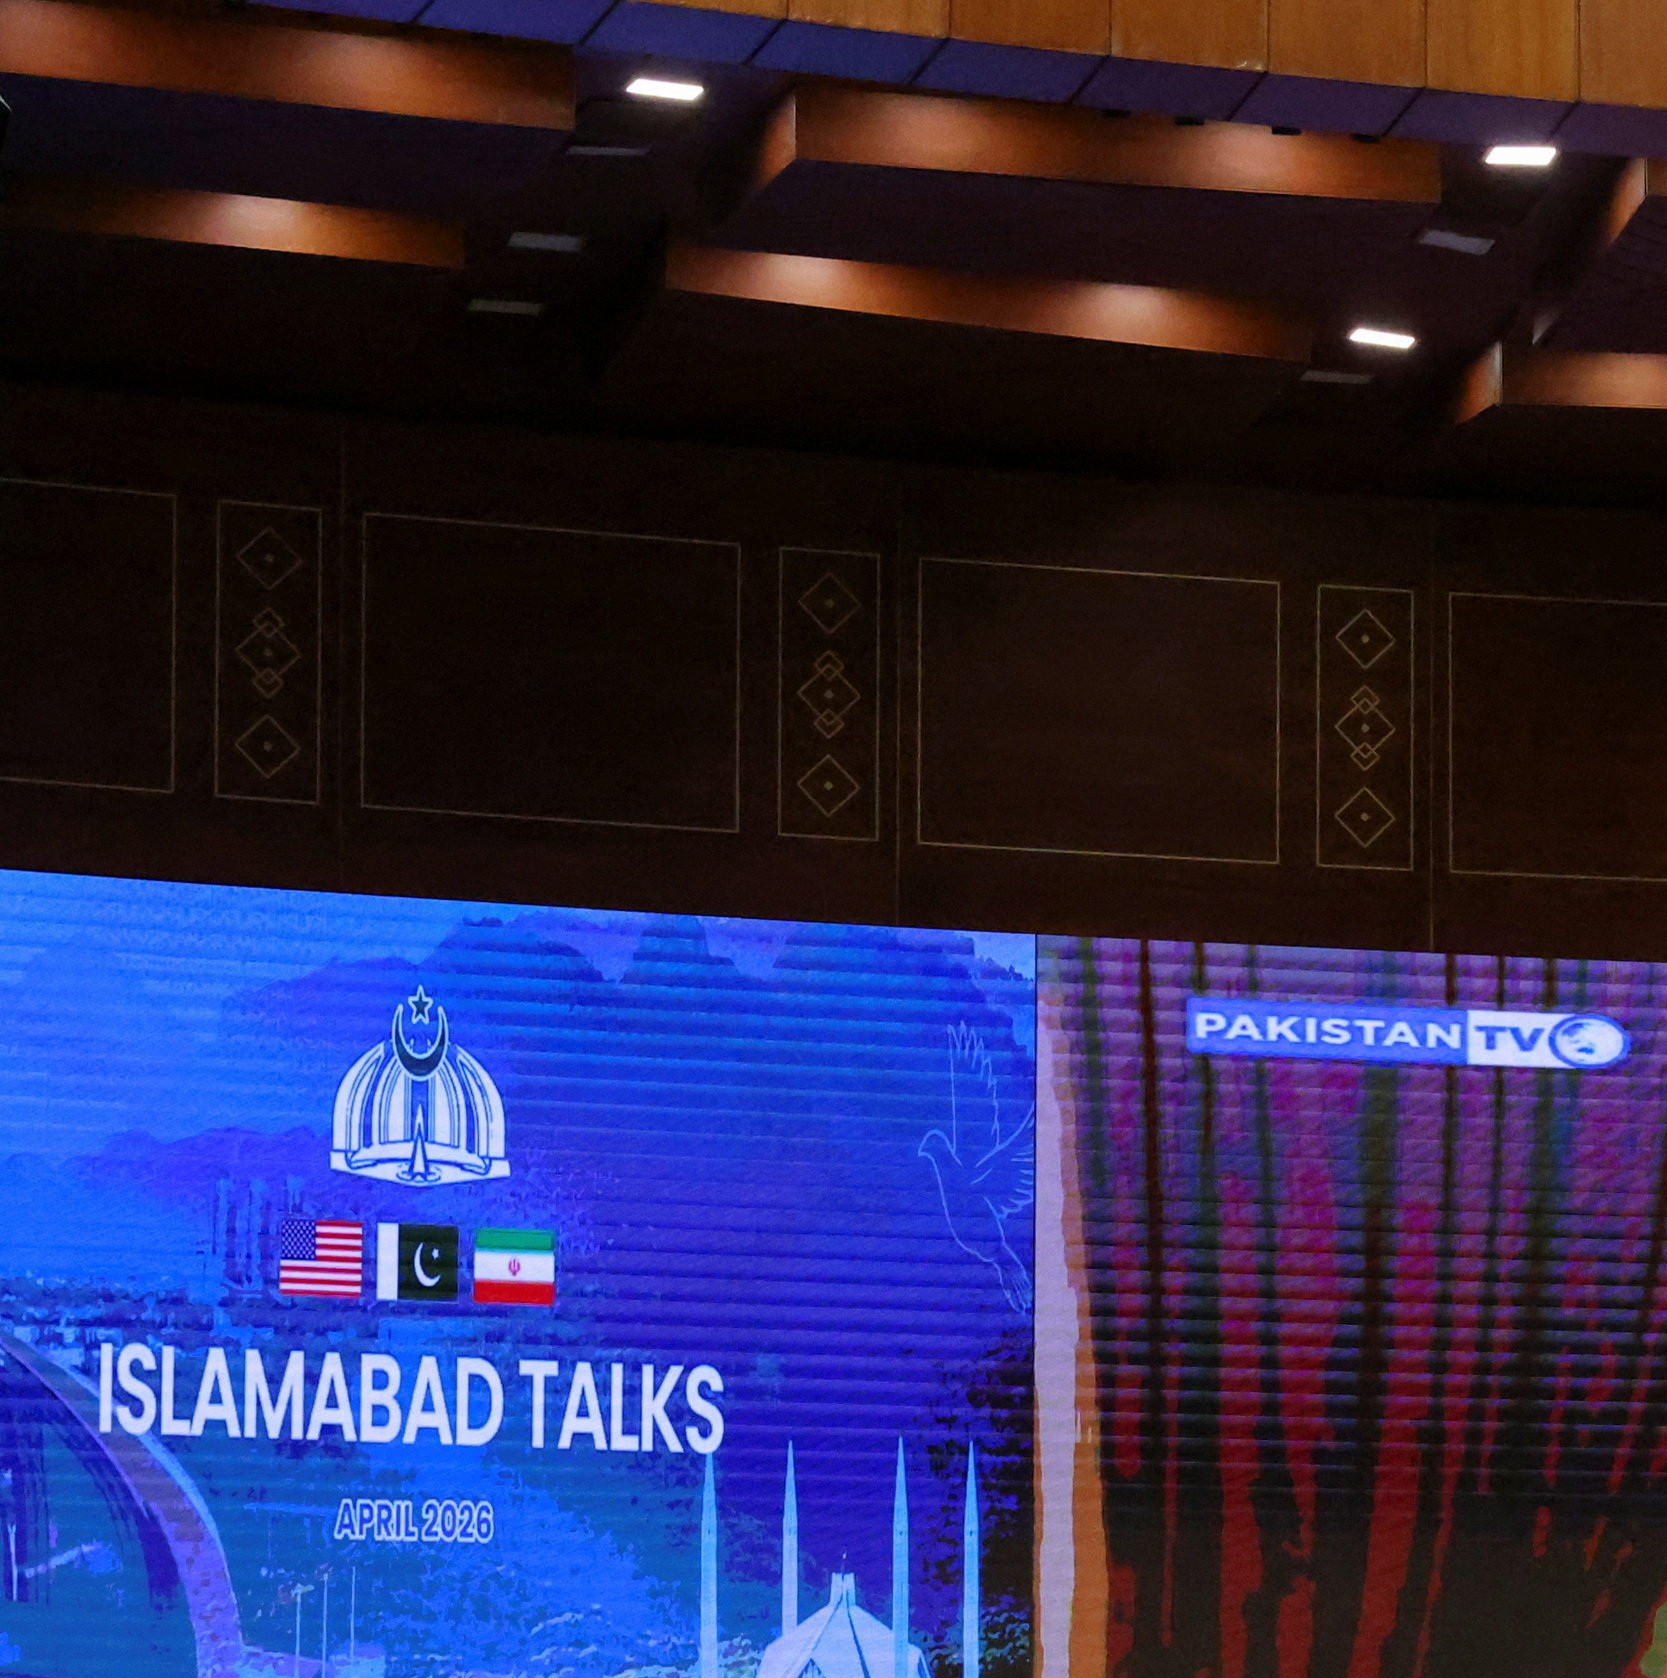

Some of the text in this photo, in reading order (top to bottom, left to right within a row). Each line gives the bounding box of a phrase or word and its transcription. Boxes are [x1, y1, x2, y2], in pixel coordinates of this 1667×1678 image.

[1195, 1013, 1546, 1053] PAKISTAN TV
[98, 1342, 726, 1455] ISLAMABAD TALKS
[334, 1498, 494, 1543] APRIL 2026
